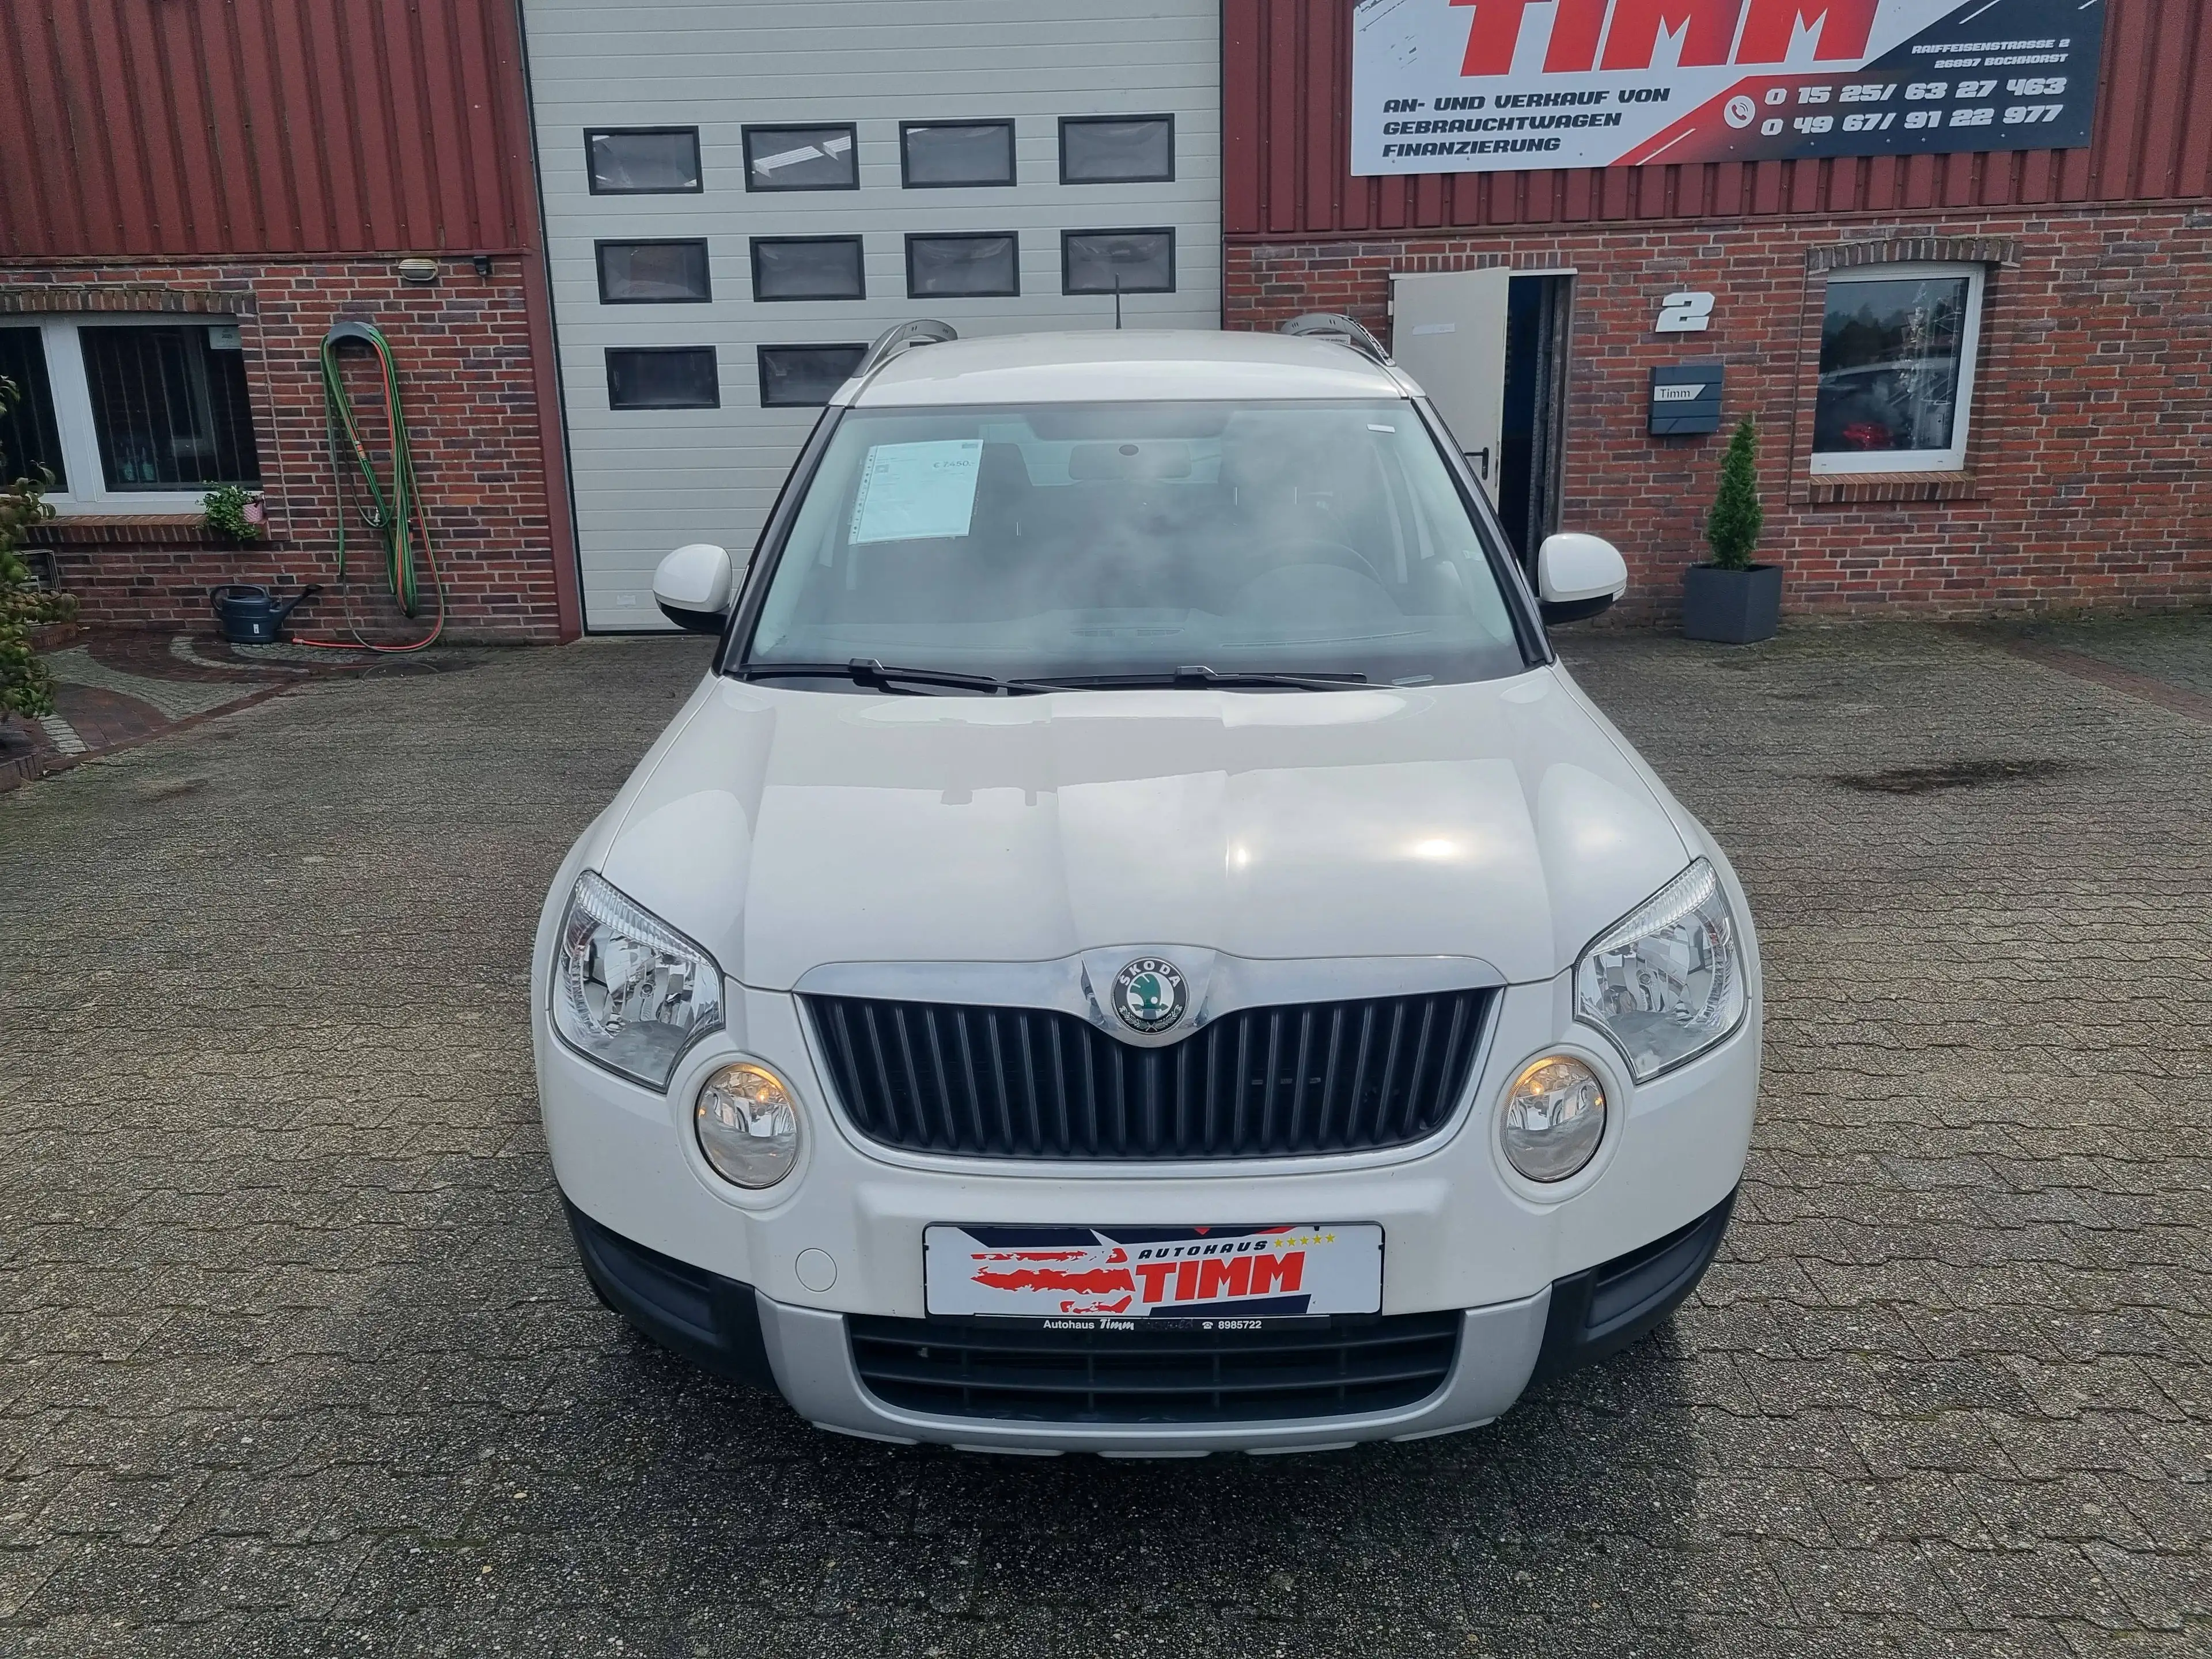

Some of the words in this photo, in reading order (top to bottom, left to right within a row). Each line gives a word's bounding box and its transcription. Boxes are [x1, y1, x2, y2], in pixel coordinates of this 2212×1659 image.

[1448, 0, 1880, 77] TIMM
[1911, 39, 2055, 54] RAIFFEISENSTRASSE
[2058, 38, 2070, 48] 2
[1934, 58, 1982, 69] 26897
[1984, 53, 2069, 67] BOCKHORST
[1383, 98, 1425, 113] AN-
[1433, 96, 1486, 111] UND
[1494, 90, 1610, 109] VERKAUF
[1618, 88, 1671, 104] VON
[1764, 88, 1787, 105] 0
[1797, 86, 1832, 104] 15
[1839, 84, 1897, 102] 25/
[1904, 82, 1948, 100] 63
[1955, 79, 1998, 98] 27
[2006, 77, 2067, 96] 463
[1383, 112, 1622, 135] GEBRAUCHTWAGEN
[1760, 118, 1783, 136] 0
[1793, 115, 1834, 134] 49
[1842, 112, 1897, 132] 67/
[1904, 110, 1942, 128] 91
[1949, 108, 1995, 127] 22
[2002, 104, 2064, 124] 977
[1382, 137, 1561, 157] FINANZIERUNG
[1655, 291, 1715, 332] 2
[1660, 388, 1691, 398] Timm
[1138, 1240, 1268, 1259] AUTOHAUS
[1135, 1251, 1306, 1304] TIMM
[1043, 1320, 1094, 1329] Autohaus
[1099, 1319, 1135, 1330] Timm
[1218, 1320, 1262, 1330] 8985722
